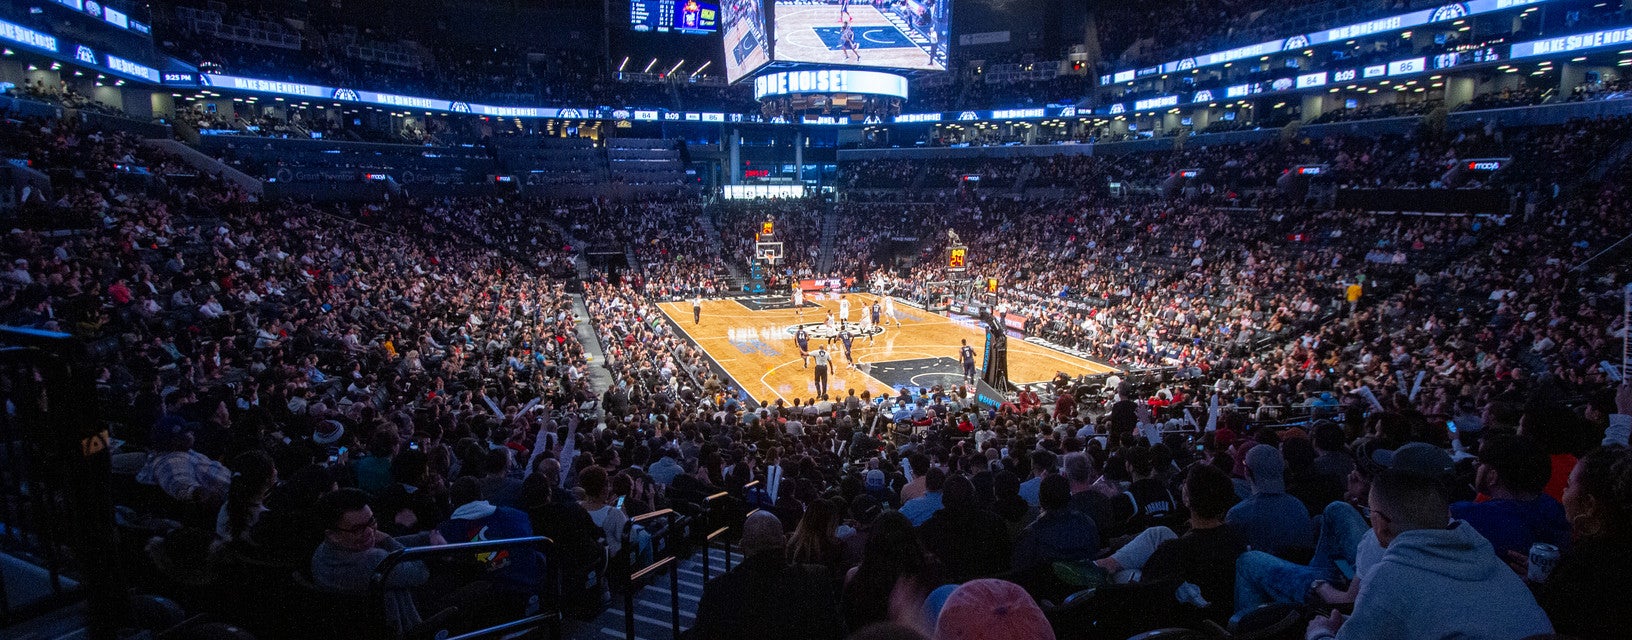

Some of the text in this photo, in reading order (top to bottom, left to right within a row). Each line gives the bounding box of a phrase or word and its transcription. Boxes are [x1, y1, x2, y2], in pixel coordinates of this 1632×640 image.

[1329, 16, 1400, 41] MAKE SOME NOISE!
[1533, 39, 1564, 54] MAKE
[1566, 32, 1603, 50] SOME
[788, 70, 847, 92] NOISE!
[1307, 76, 1317, 84] 84
[1334, 70, 1356, 82] 8:09
[1400, 61, 1413, 72] 86
[235, 78, 308, 95] MAKE SOME NOISE!
[378, 94, 432, 108] MAKE SOME NOISE!
[484, 105, 537, 117] MAKE SOME NOISE!
[950, 256, 963, 267] 24
